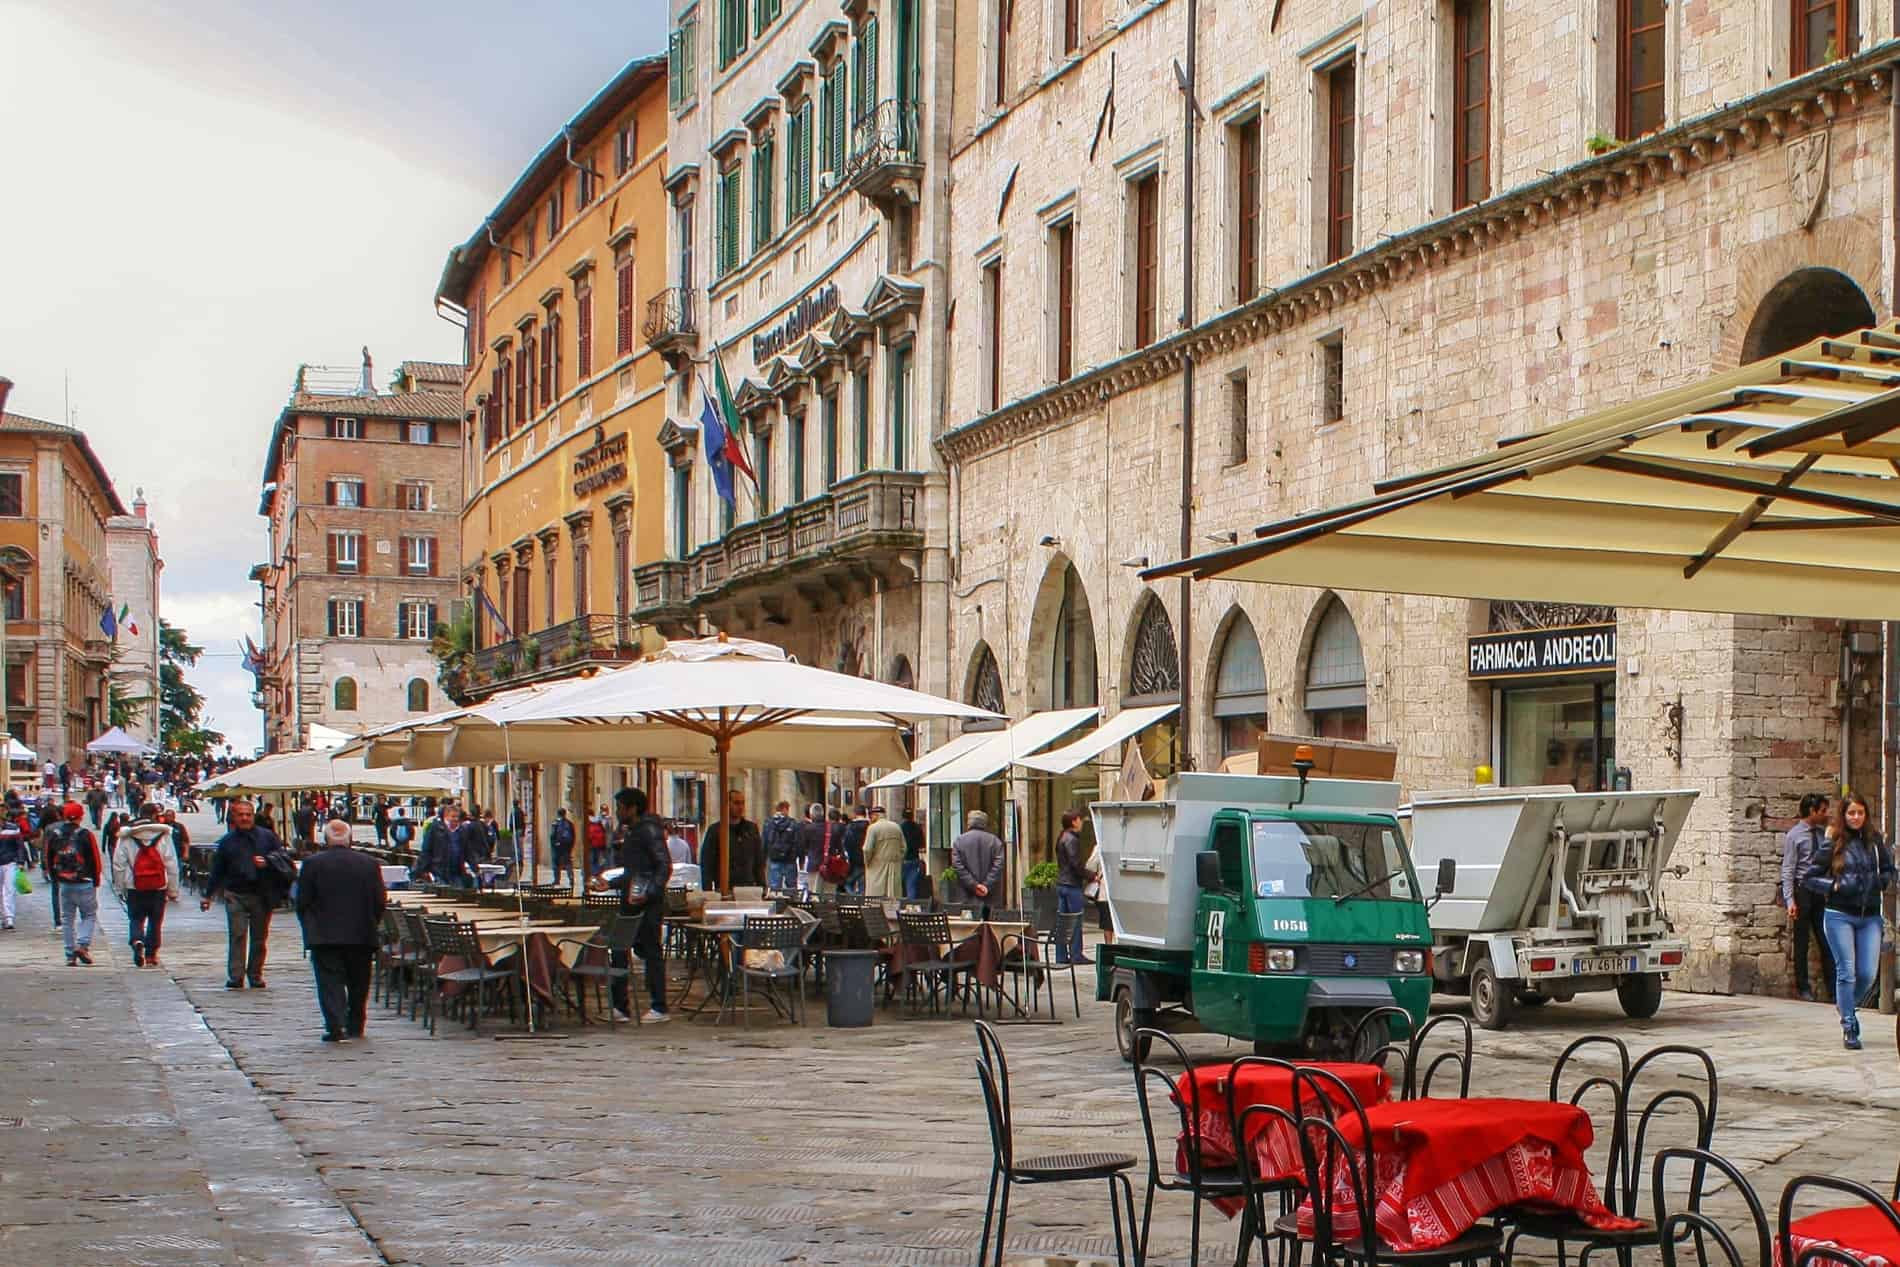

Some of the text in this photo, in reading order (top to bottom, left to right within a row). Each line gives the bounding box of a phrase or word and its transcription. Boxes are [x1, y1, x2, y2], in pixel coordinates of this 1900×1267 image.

[1470, 632, 1616, 671] FARMACIA ANDREOLI
[1581, 959, 1593, 972] CV
